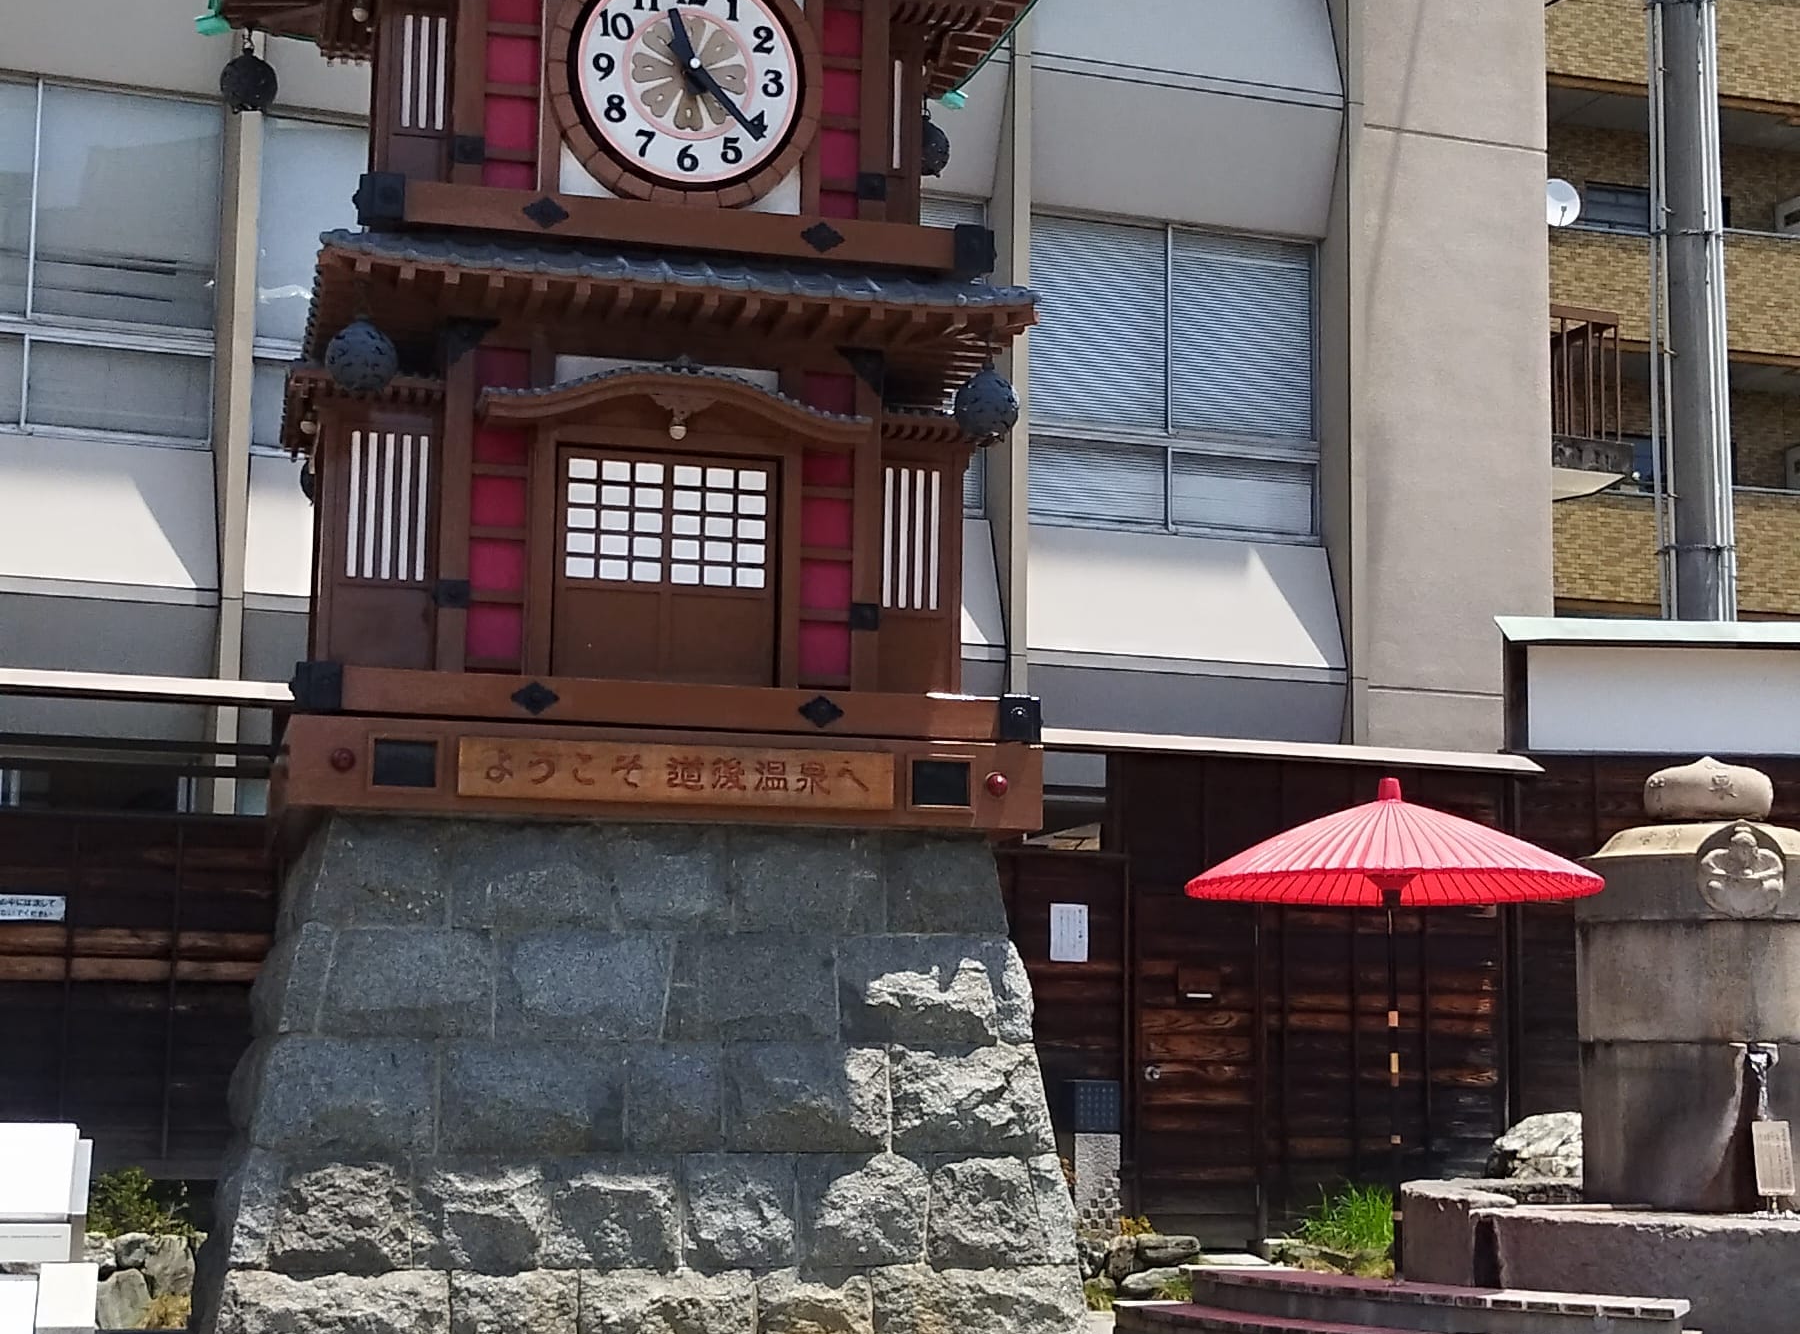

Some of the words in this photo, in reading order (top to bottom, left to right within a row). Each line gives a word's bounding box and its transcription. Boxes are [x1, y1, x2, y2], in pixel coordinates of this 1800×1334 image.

[599, 8, 634, 40] 10
[752, 25, 775, 55] 2
[592, 53, 615, 81] 9
[761, 69, 785, 97] 3
[604, 94, 627, 123] 8
[634, 129, 656, 157] 7
[720, 137, 743, 164] 5
[676, 144, 699, 172] 6
[481, 749, 643, 788] ようこそ
[666, 756, 870, 796] 道後温泉へ
